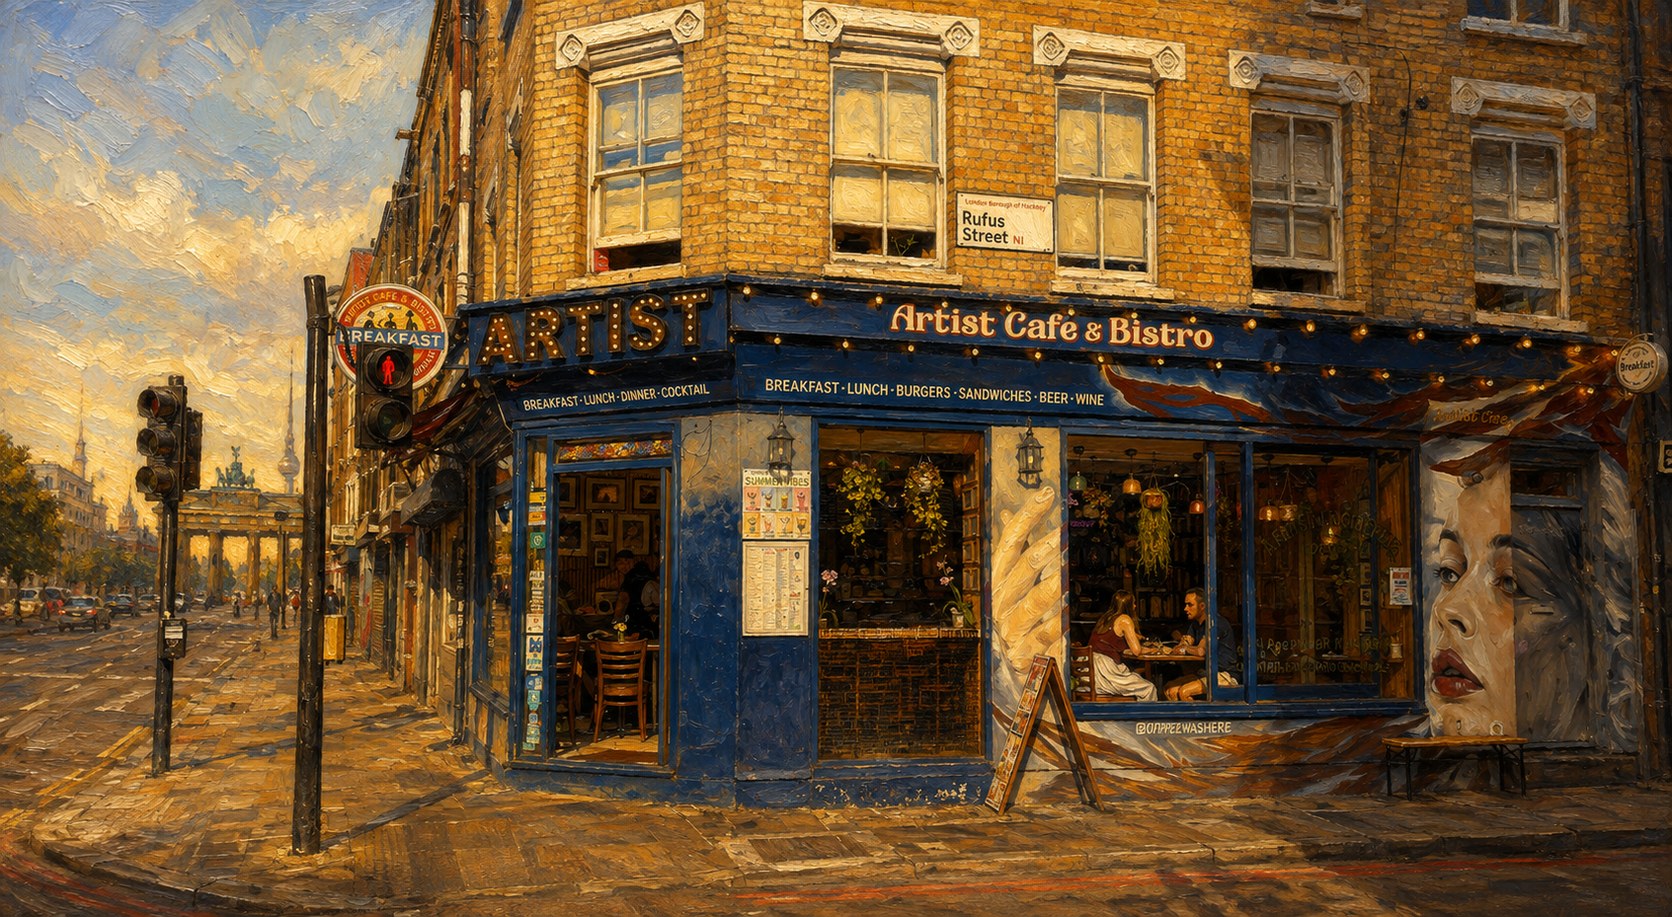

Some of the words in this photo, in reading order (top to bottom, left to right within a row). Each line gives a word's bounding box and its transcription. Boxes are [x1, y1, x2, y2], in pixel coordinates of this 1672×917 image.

[962, 210, 1005, 228] Rufus
[962, 227, 1009, 244] Street
[339, 330, 442, 348] BREAKFAST
[478, 289, 713, 365] ARTIST
[890, 303, 997, 337] Artist
[1084, 321, 1103, 343] &
[1108, 315, 1216, 351] Bistro
[523, 395, 579, 412] BREAKFAST
[583, 391, 615, 406] LUNCH
[621, 388, 657, 402] DINNER
[661, 383, 710, 398] COCKTAIL
[765, 378, 839, 394] BREAKFAST
[847, 382, 888, 396] LUNCH
[896, 384, 951, 400] BURGERS
[958, 386, 1032, 402] SANDWICHES
[1039, 391, 1069, 404] BEER
[1075, 393, 1105, 406] WINE
